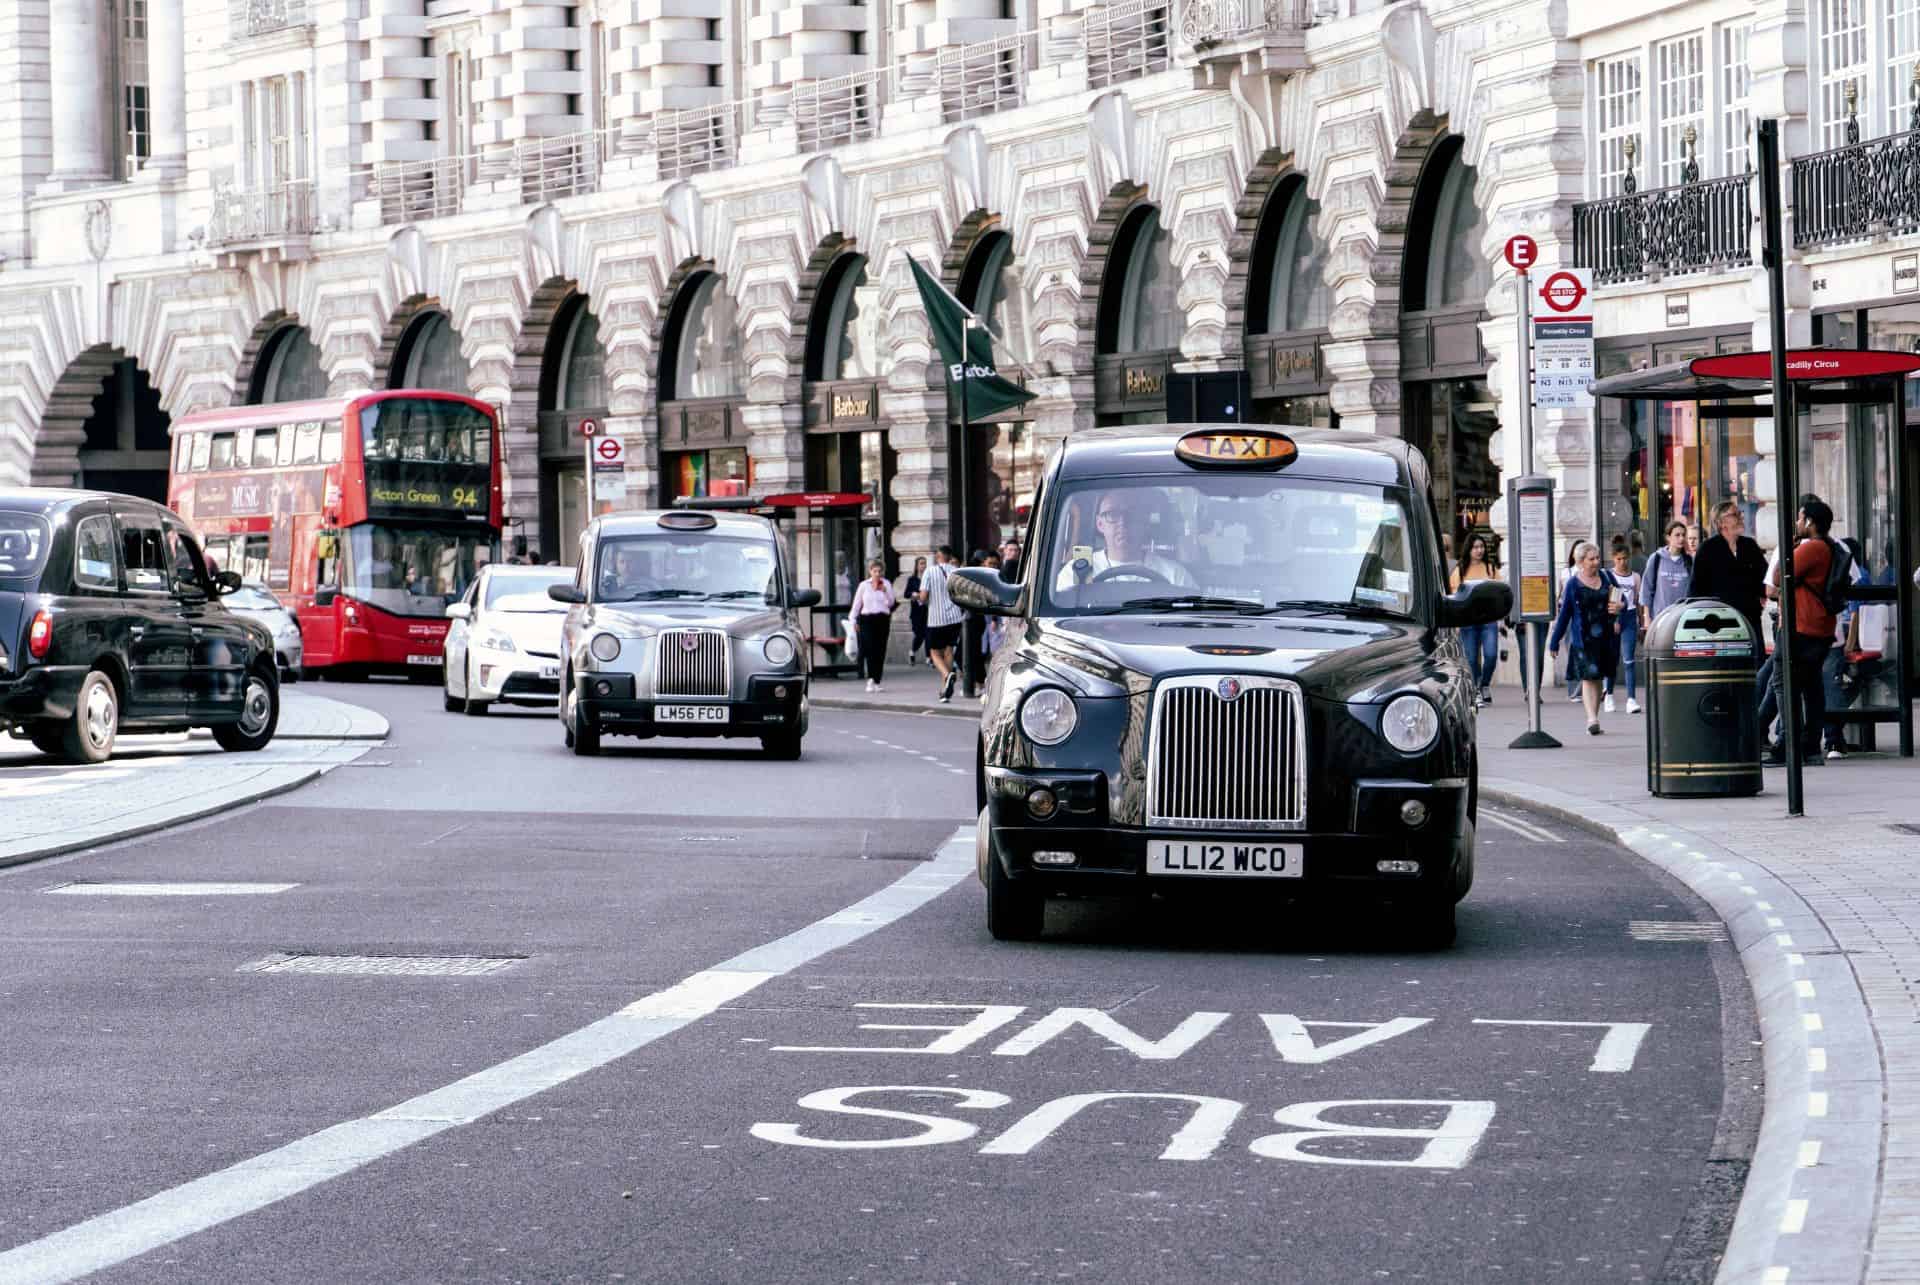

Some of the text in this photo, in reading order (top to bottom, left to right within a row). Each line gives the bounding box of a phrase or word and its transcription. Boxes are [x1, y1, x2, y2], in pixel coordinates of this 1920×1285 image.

[1513, 240, 1529, 263] E
[1786, 360, 1839, 370] cadilly Circus
[1127, 368, 1163, 394] Barbour
[834, 396, 869, 416] Barbour
[584, 422, 595, 434] D
[1201, 438, 1271, 456] TAXI
[373, 487, 477, 508] Acton Green 94
[698, 707, 724, 720] FCO
[1165, 845, 1286, 871] LL12 WCO
[769, 1002, 1653, 1073] LANE
[749, 1085, 1496, 1169] BUS
